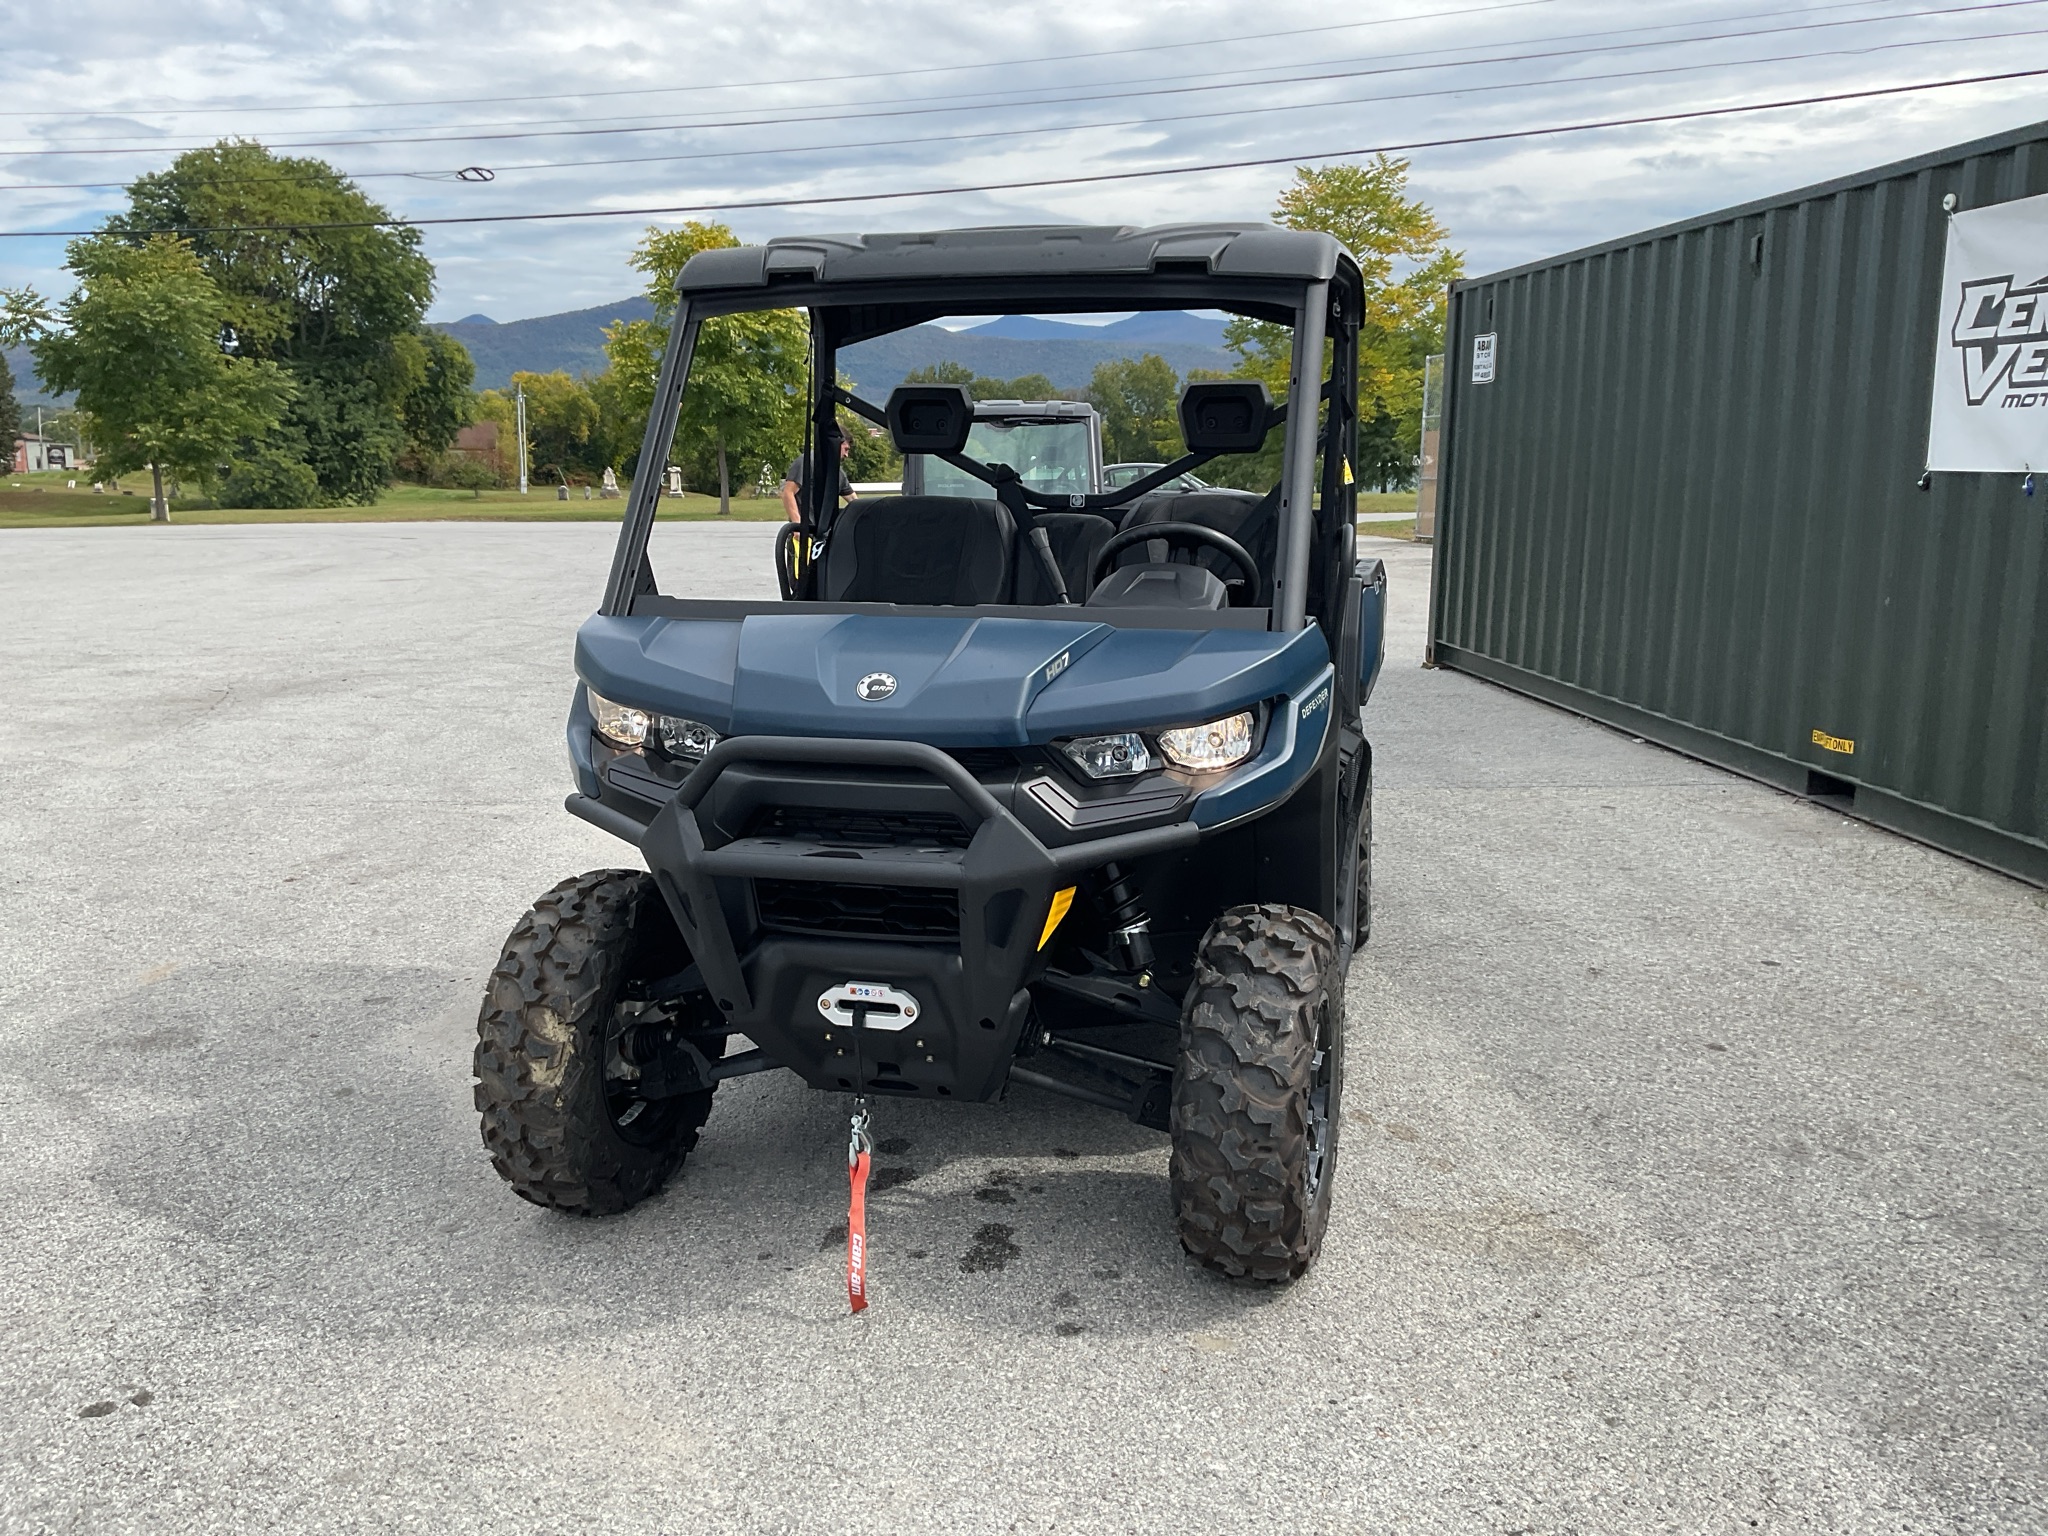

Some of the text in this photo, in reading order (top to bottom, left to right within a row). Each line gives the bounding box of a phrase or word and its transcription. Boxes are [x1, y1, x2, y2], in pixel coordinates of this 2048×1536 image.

[1962, 341, 2048, 406] VE
[1046, 652, 1069, 681] HD7
[1833, 740, 1852, 752] ONLY
